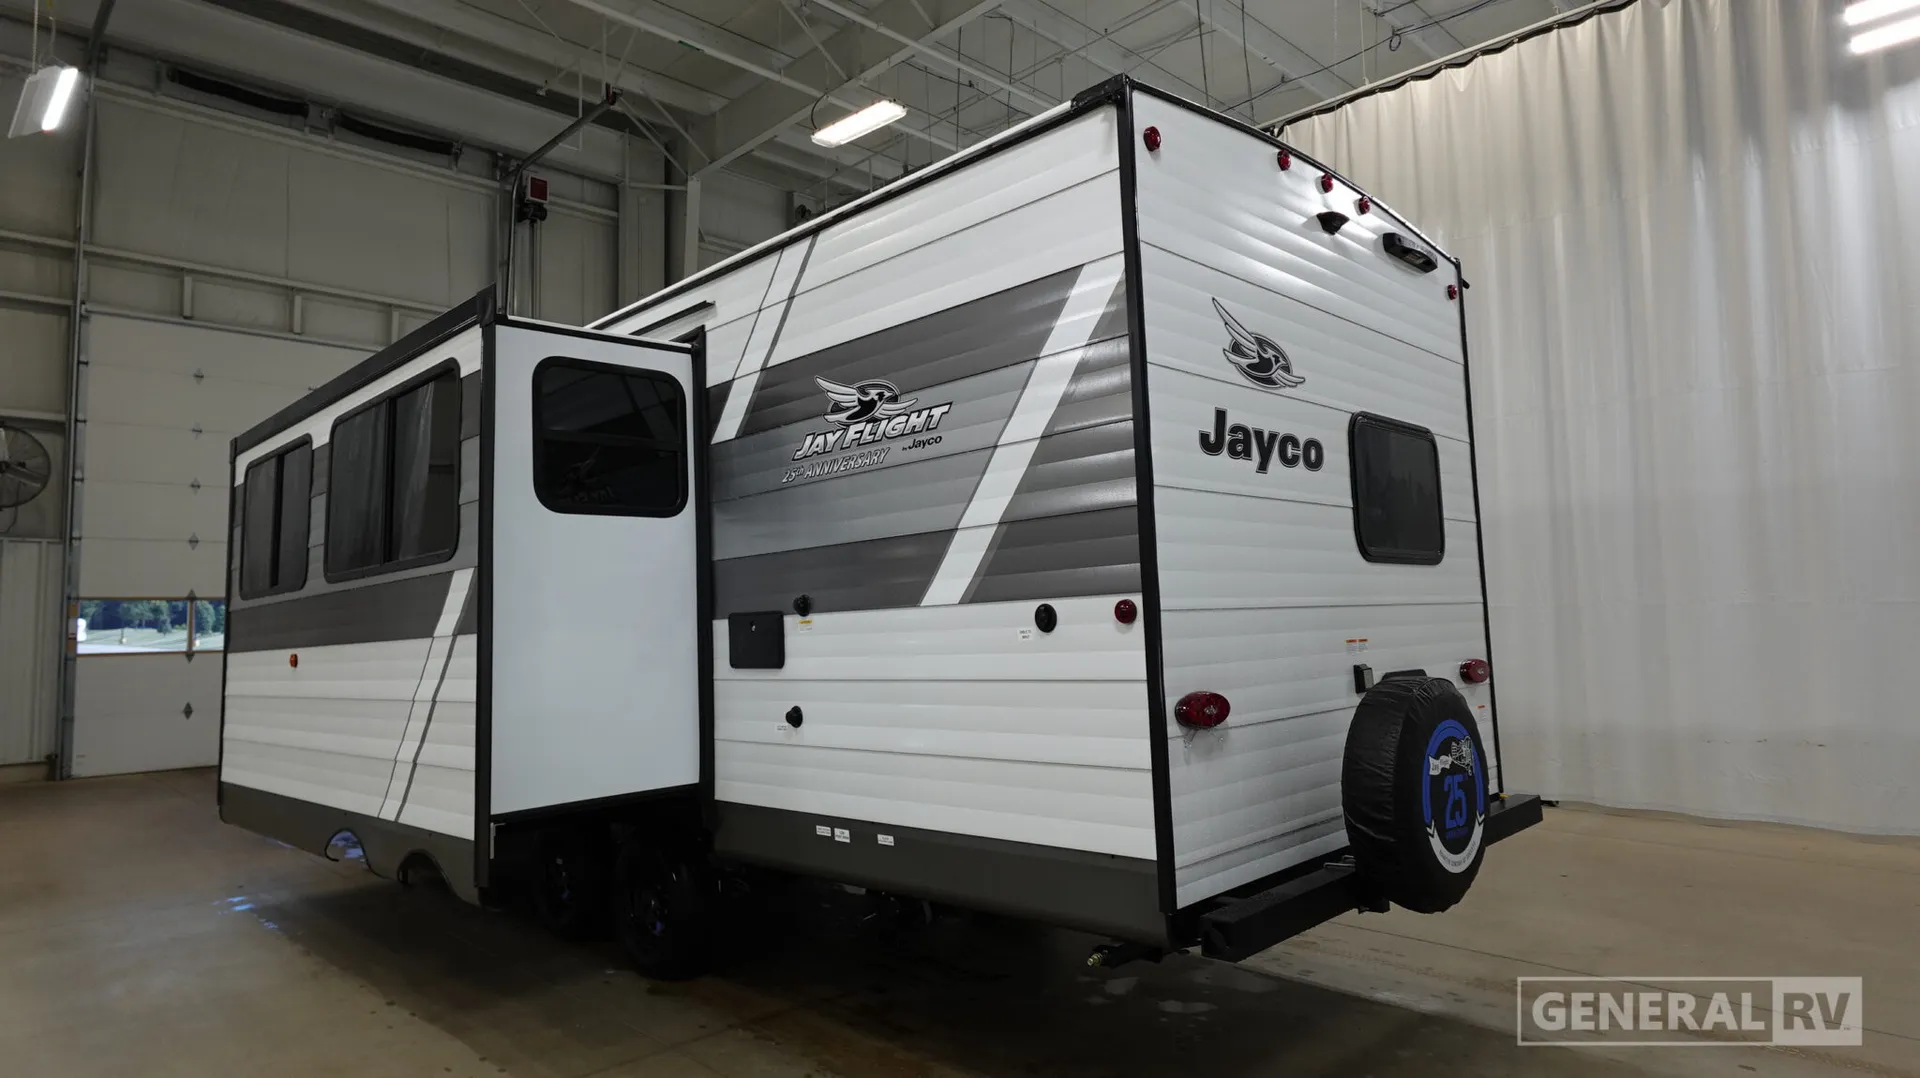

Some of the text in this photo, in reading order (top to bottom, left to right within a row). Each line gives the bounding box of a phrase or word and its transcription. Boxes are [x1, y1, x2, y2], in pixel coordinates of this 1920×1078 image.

[792, 401, 953, 461] JAY FLIGHT
[908, 435, 942, 449] Jayco
[1198, 406, 1325, 475] Jayco
[804, 447, 890, 479] ANNIVERSARY
[1443, 773, 1468, 829] 25
